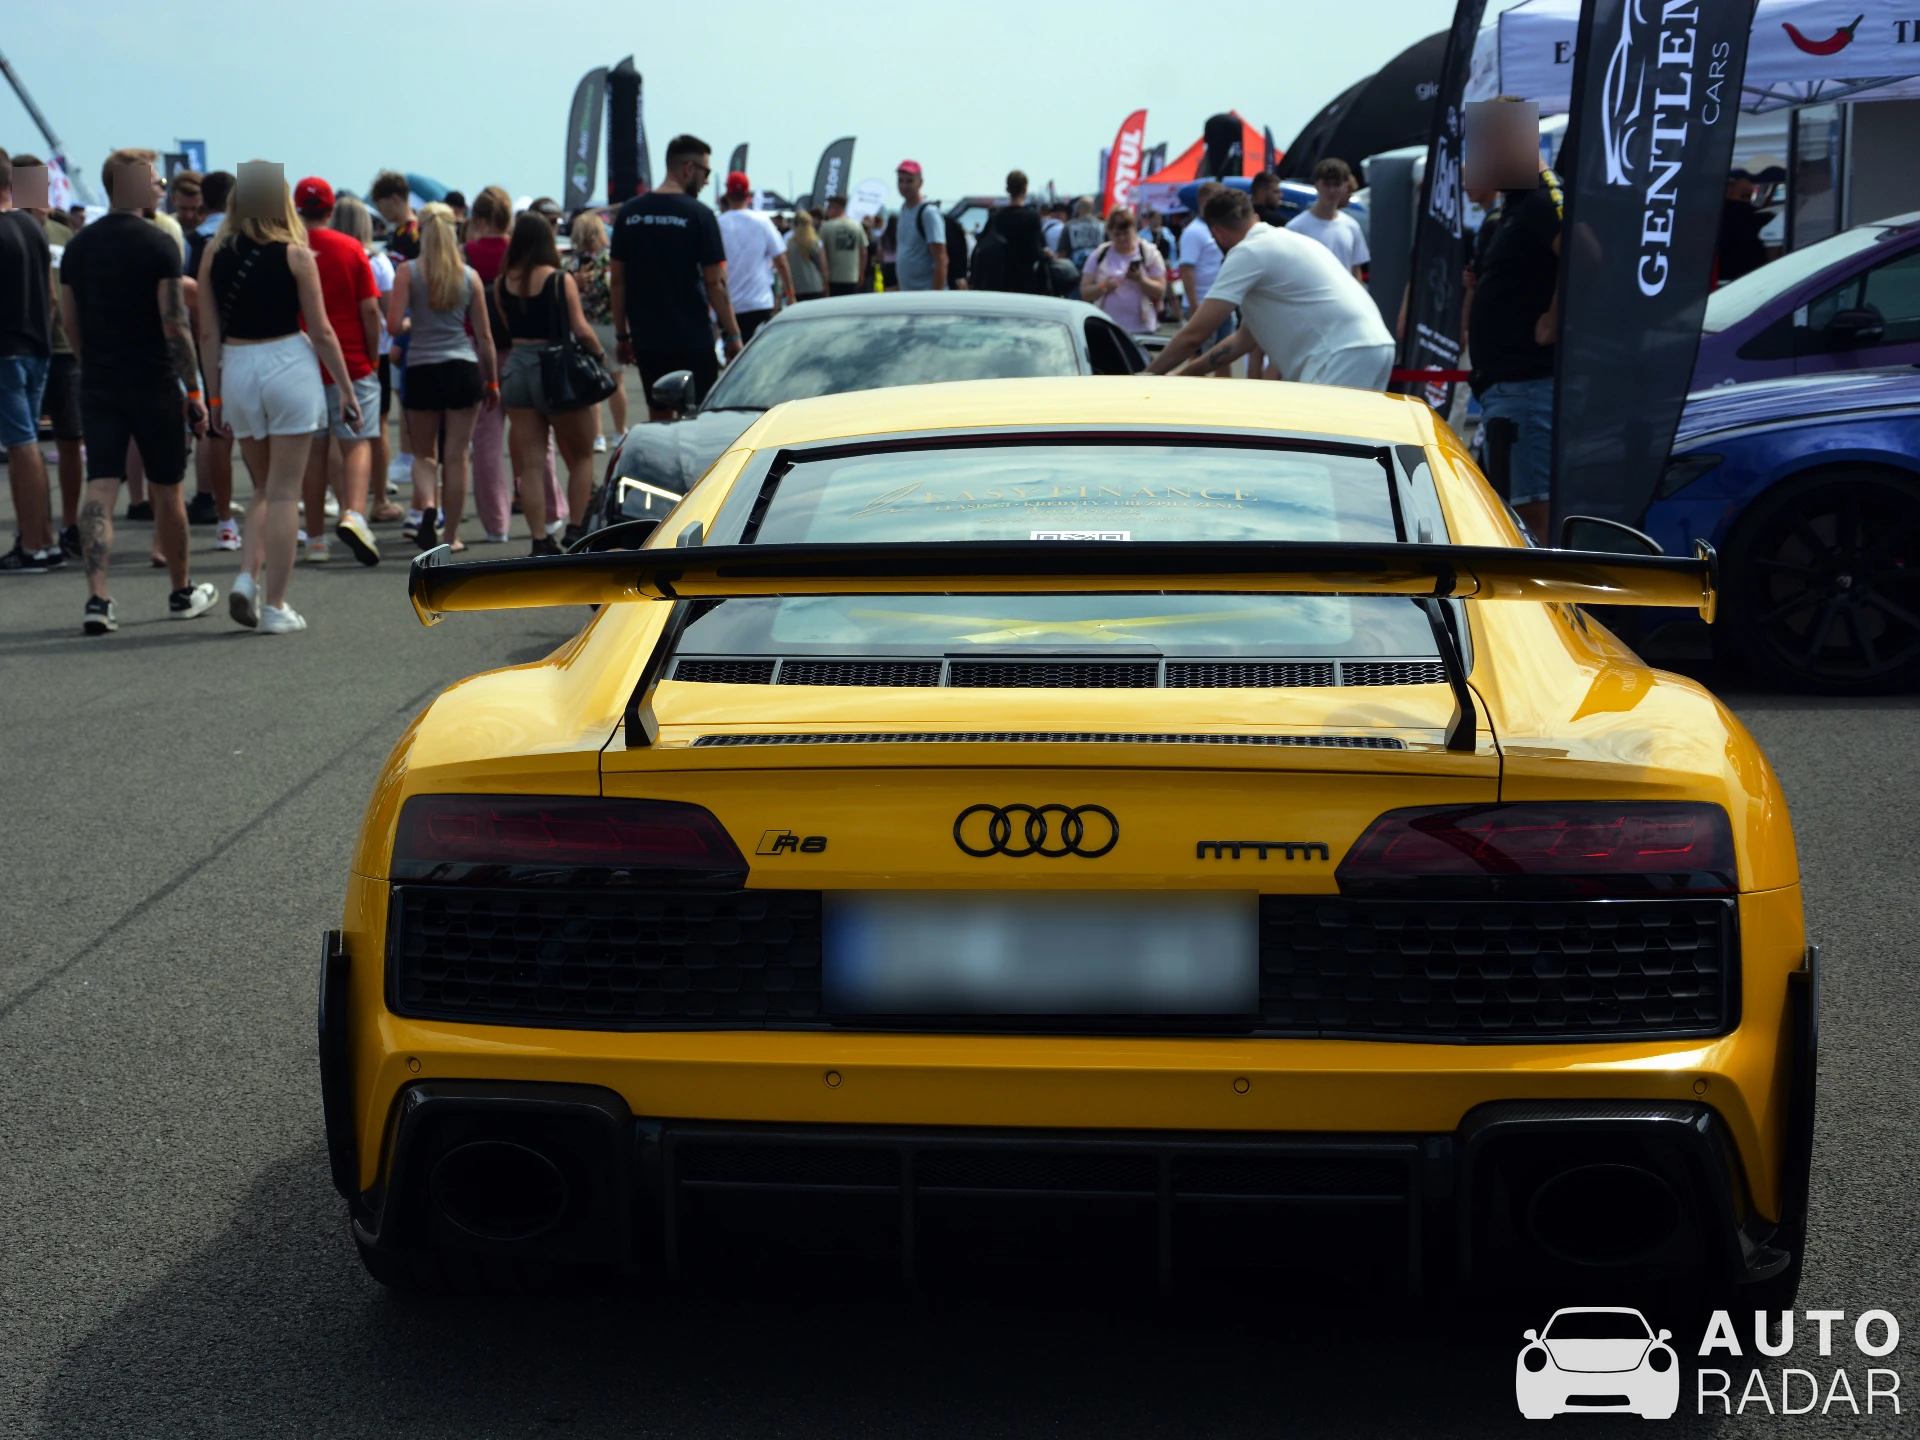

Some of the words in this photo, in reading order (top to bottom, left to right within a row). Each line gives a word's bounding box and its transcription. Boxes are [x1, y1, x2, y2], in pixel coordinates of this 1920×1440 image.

[1702, 42, 1730, 125] CARS
[925, 487, 1036, 504] EASY
[1052, 486, 1258, 502] FINANCE
[769, 834, 828, 853] R8
